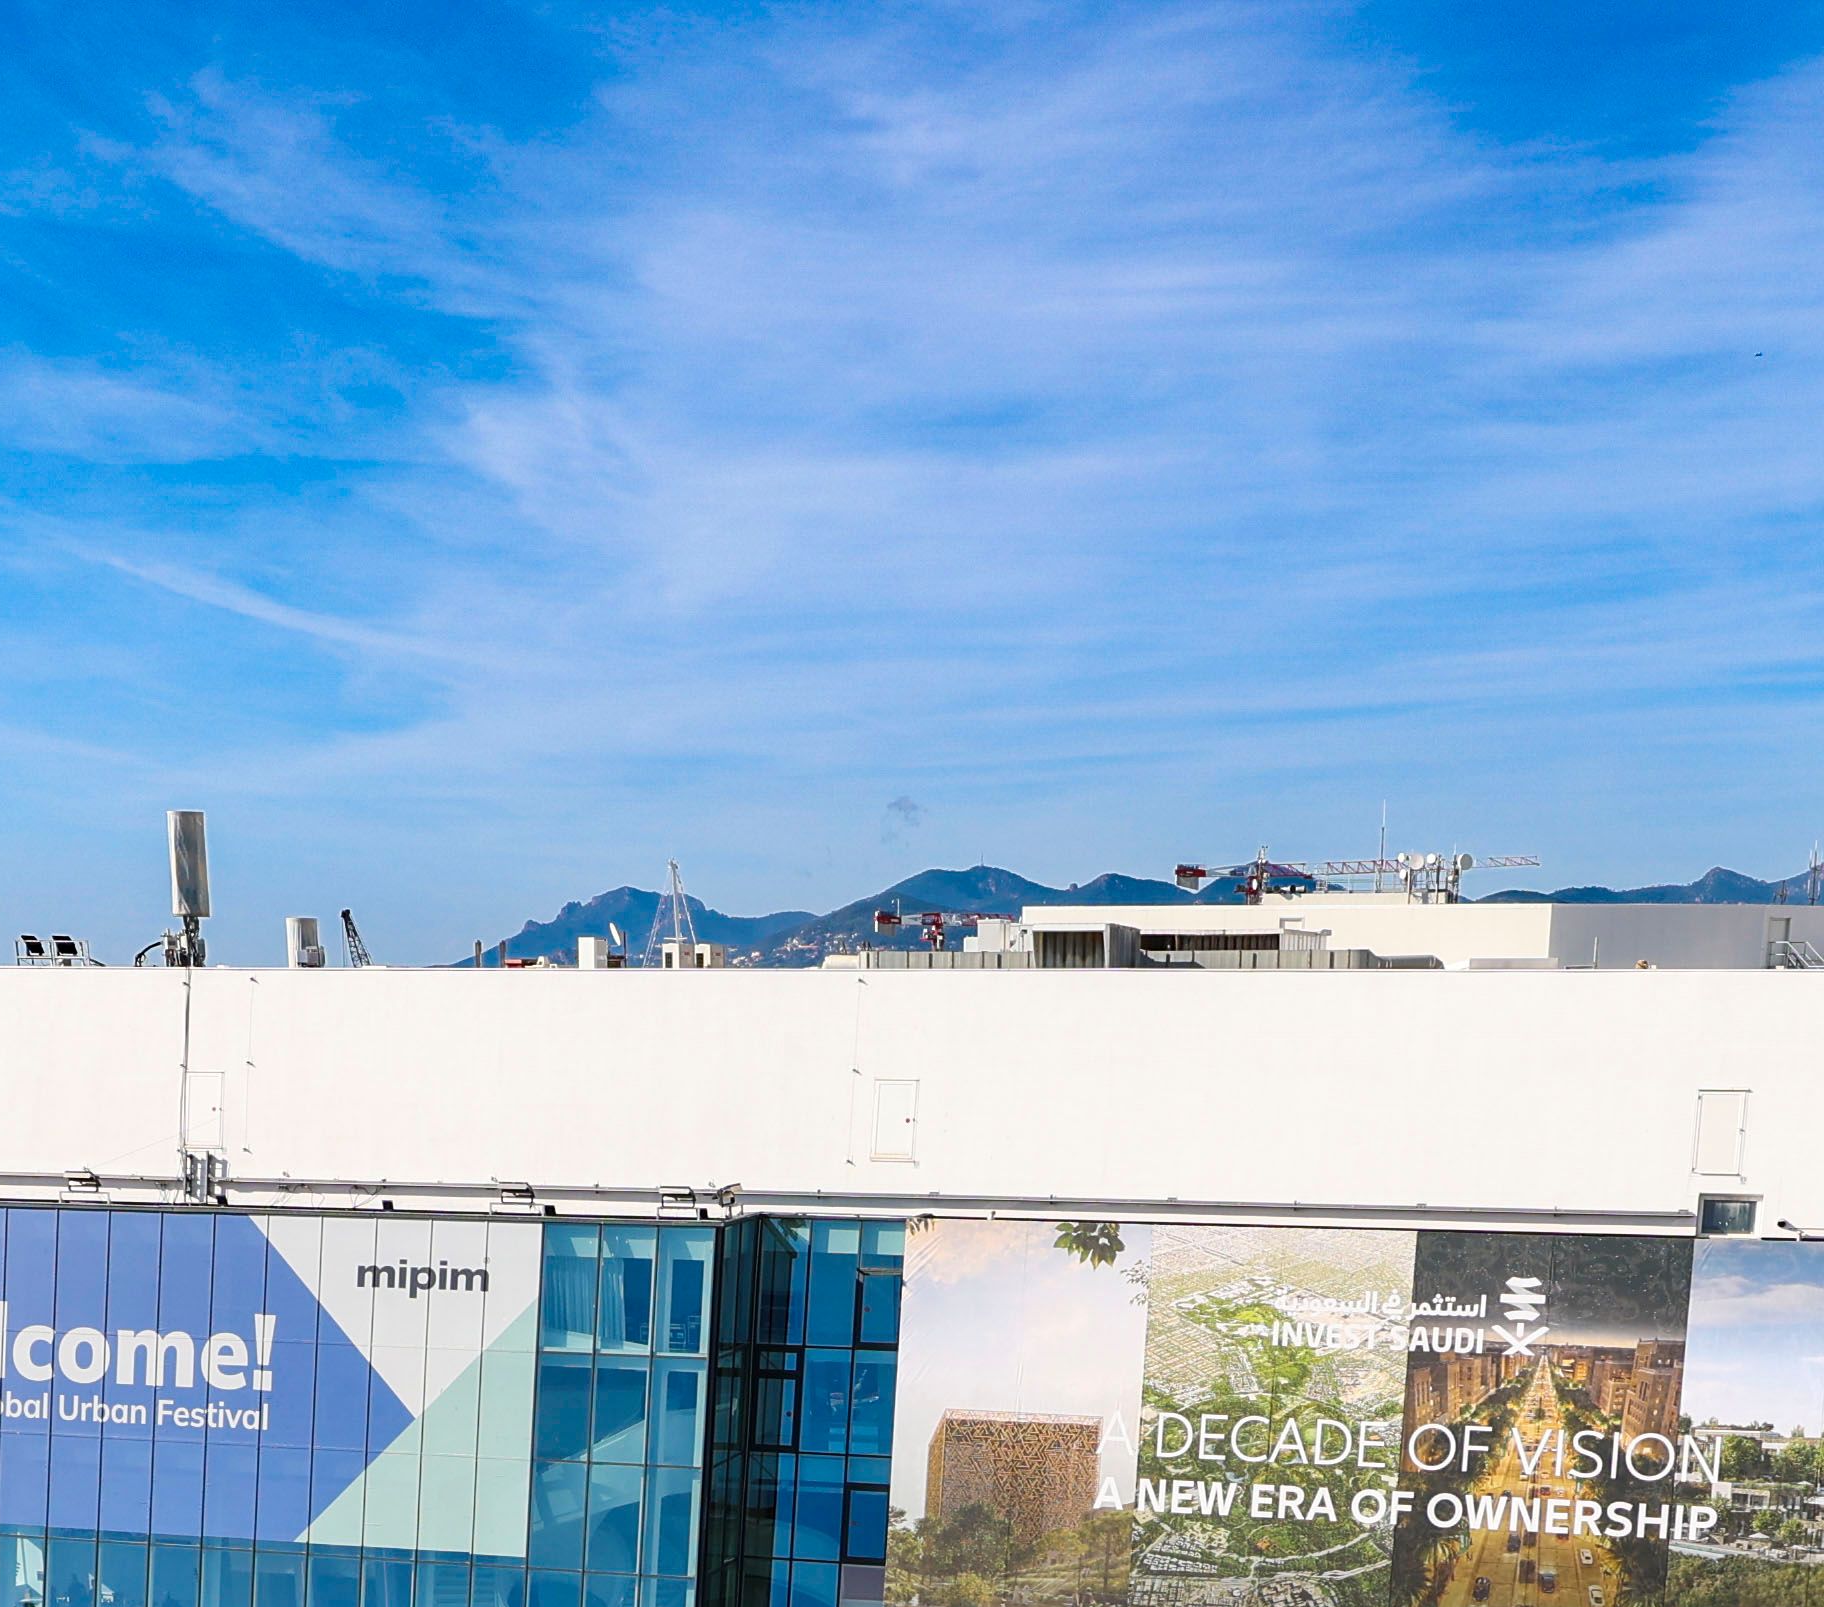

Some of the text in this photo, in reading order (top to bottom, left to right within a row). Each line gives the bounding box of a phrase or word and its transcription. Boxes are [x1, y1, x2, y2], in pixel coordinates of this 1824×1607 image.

[357, 1261, 489, 1298] mipim
[1404, 1293, 1486, 1320] استثمر
[1272, 1320, 1484, 1354] INVEST SAUDI
[58, 1393, 147, 1426] Urban
[157, 1399, 269, 1431] Festival
[1096, 1410, 1723, 1484] A DECADE OF VISION
[1094, 1475, 1718, 1542] A NEW ERA OF OWNERSHIP
